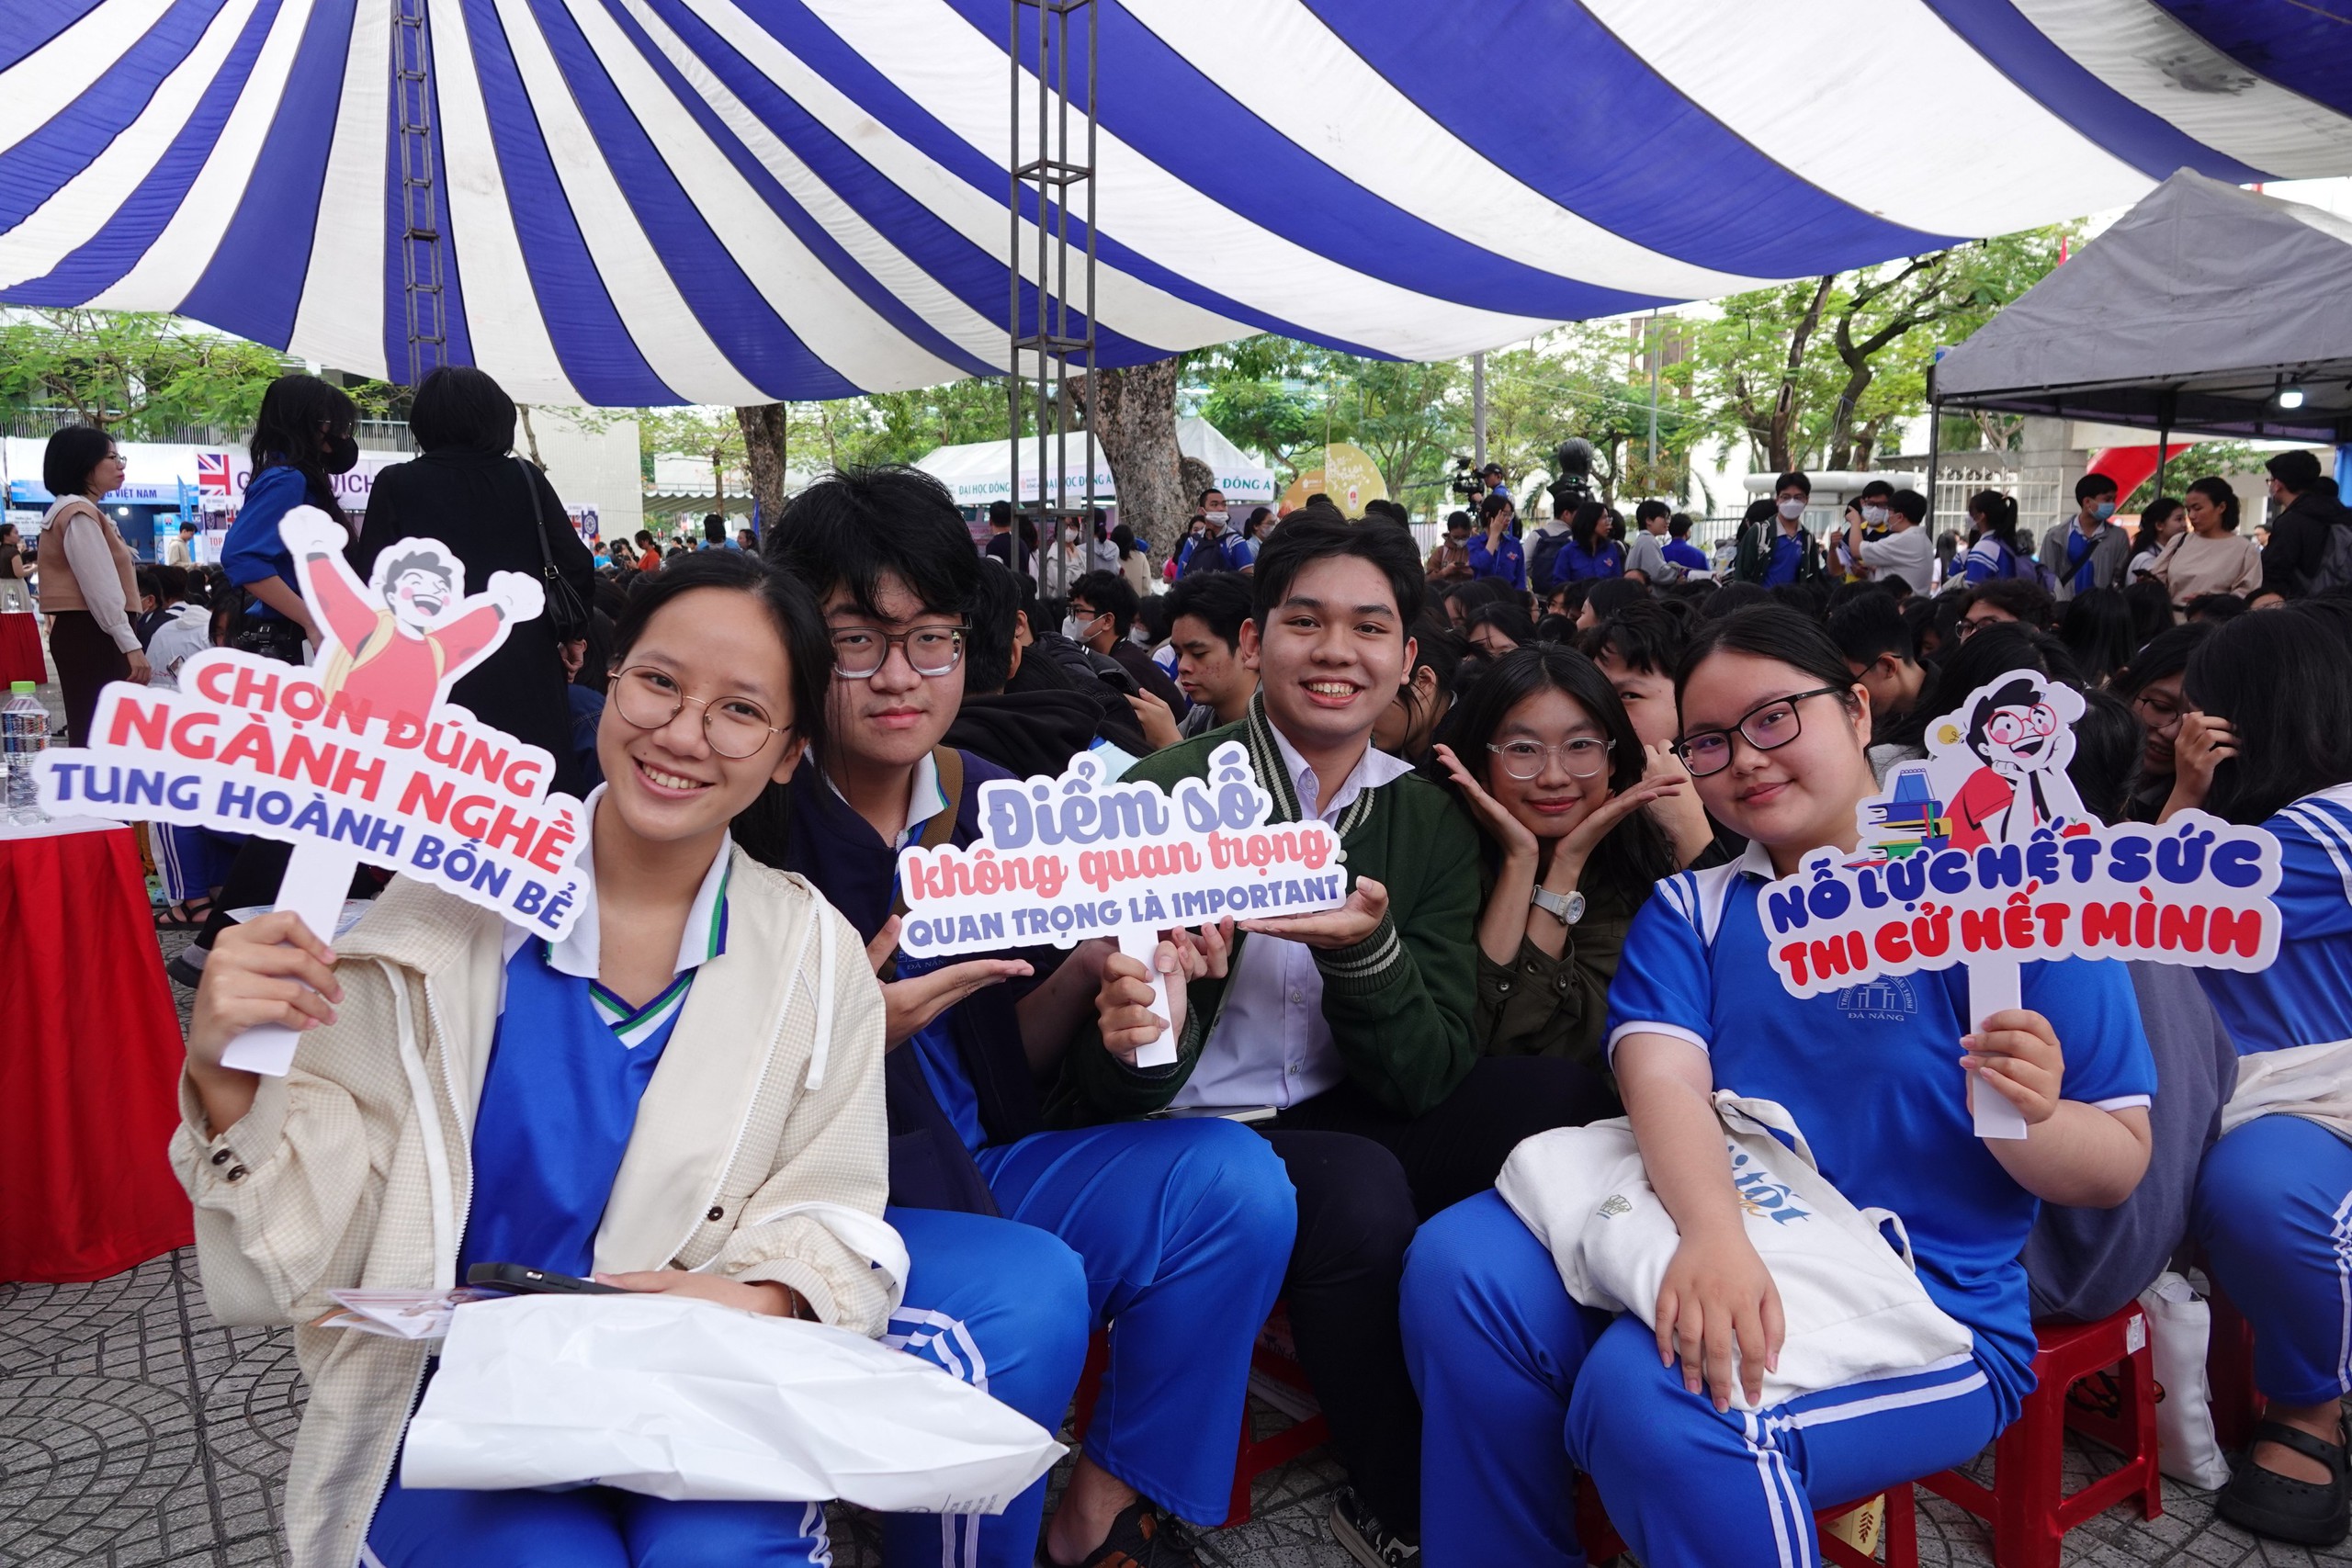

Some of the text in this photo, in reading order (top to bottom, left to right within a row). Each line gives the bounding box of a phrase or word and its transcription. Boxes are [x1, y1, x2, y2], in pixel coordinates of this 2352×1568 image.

[116, 487, 133, 501] VIỆT
[136, 489, 157, 499] NAM
[1223, 476, 1260, 490] ĐÔNG
[197, 662, 542, 797] CHỌN ĐÚNG
[108, 697, 576, 874] NGÀNH NGHỀ
[988, 750, 1264, 850] Điểm số
[51, 763, 577, 931] TUNG HOÀNH BỐN BỂ
[909, 829, 1332, 900] không quan trọng
[1769, 816, 2262, 933] NỖ LỰC HẾT SỨC
[907, 874, 1339, 947] QUAN TRỌNG LÀ IMPORTANT
[1780, 880, 2262, 986] THI CỬ HẾT MÌNH
